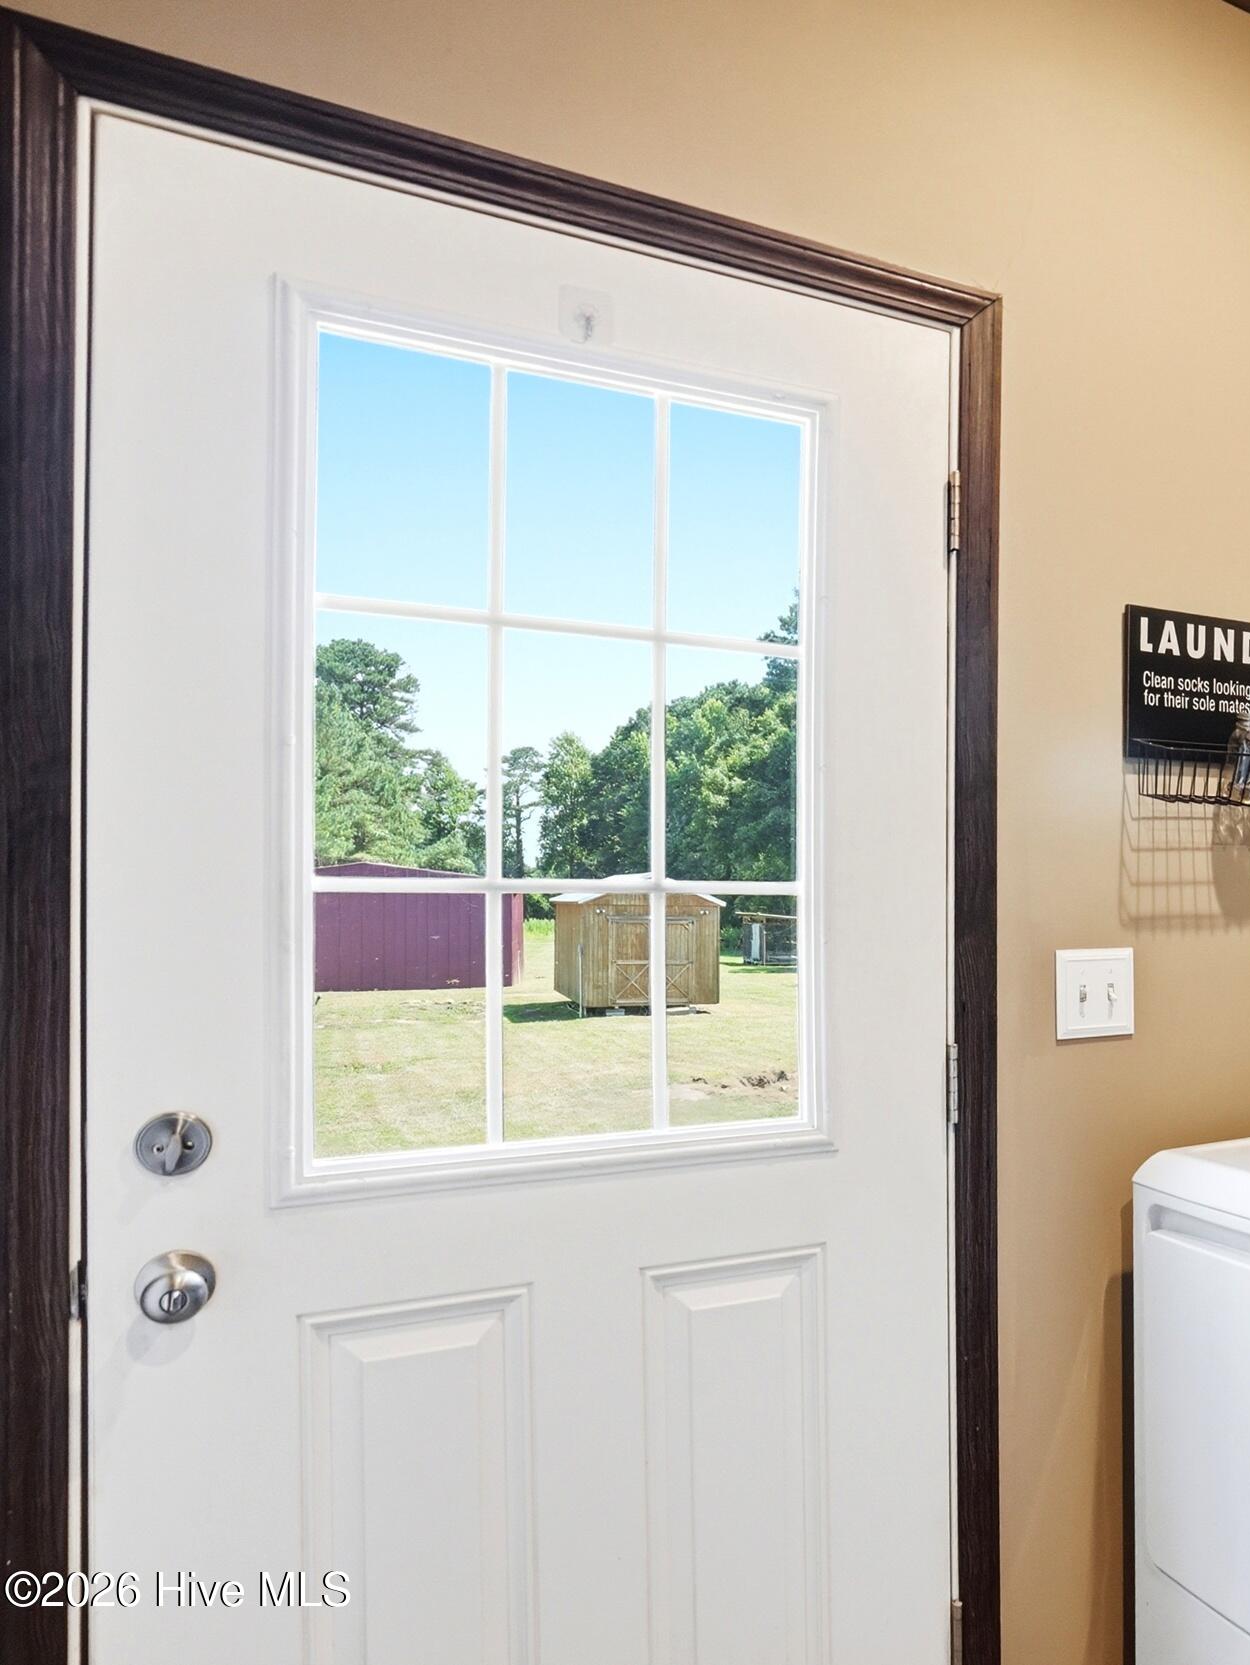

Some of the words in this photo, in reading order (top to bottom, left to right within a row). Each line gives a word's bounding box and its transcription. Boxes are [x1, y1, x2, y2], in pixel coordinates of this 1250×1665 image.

[1143, 670, 1174, 690] Clean
[1177, 677, 1210, 694] socks
[1143, 691, 1159, 706] for
[1164, 693, 1189, 710] their
[1192, 697, 1215, 712] sole
[1218, 699, 1250, 714] mates
